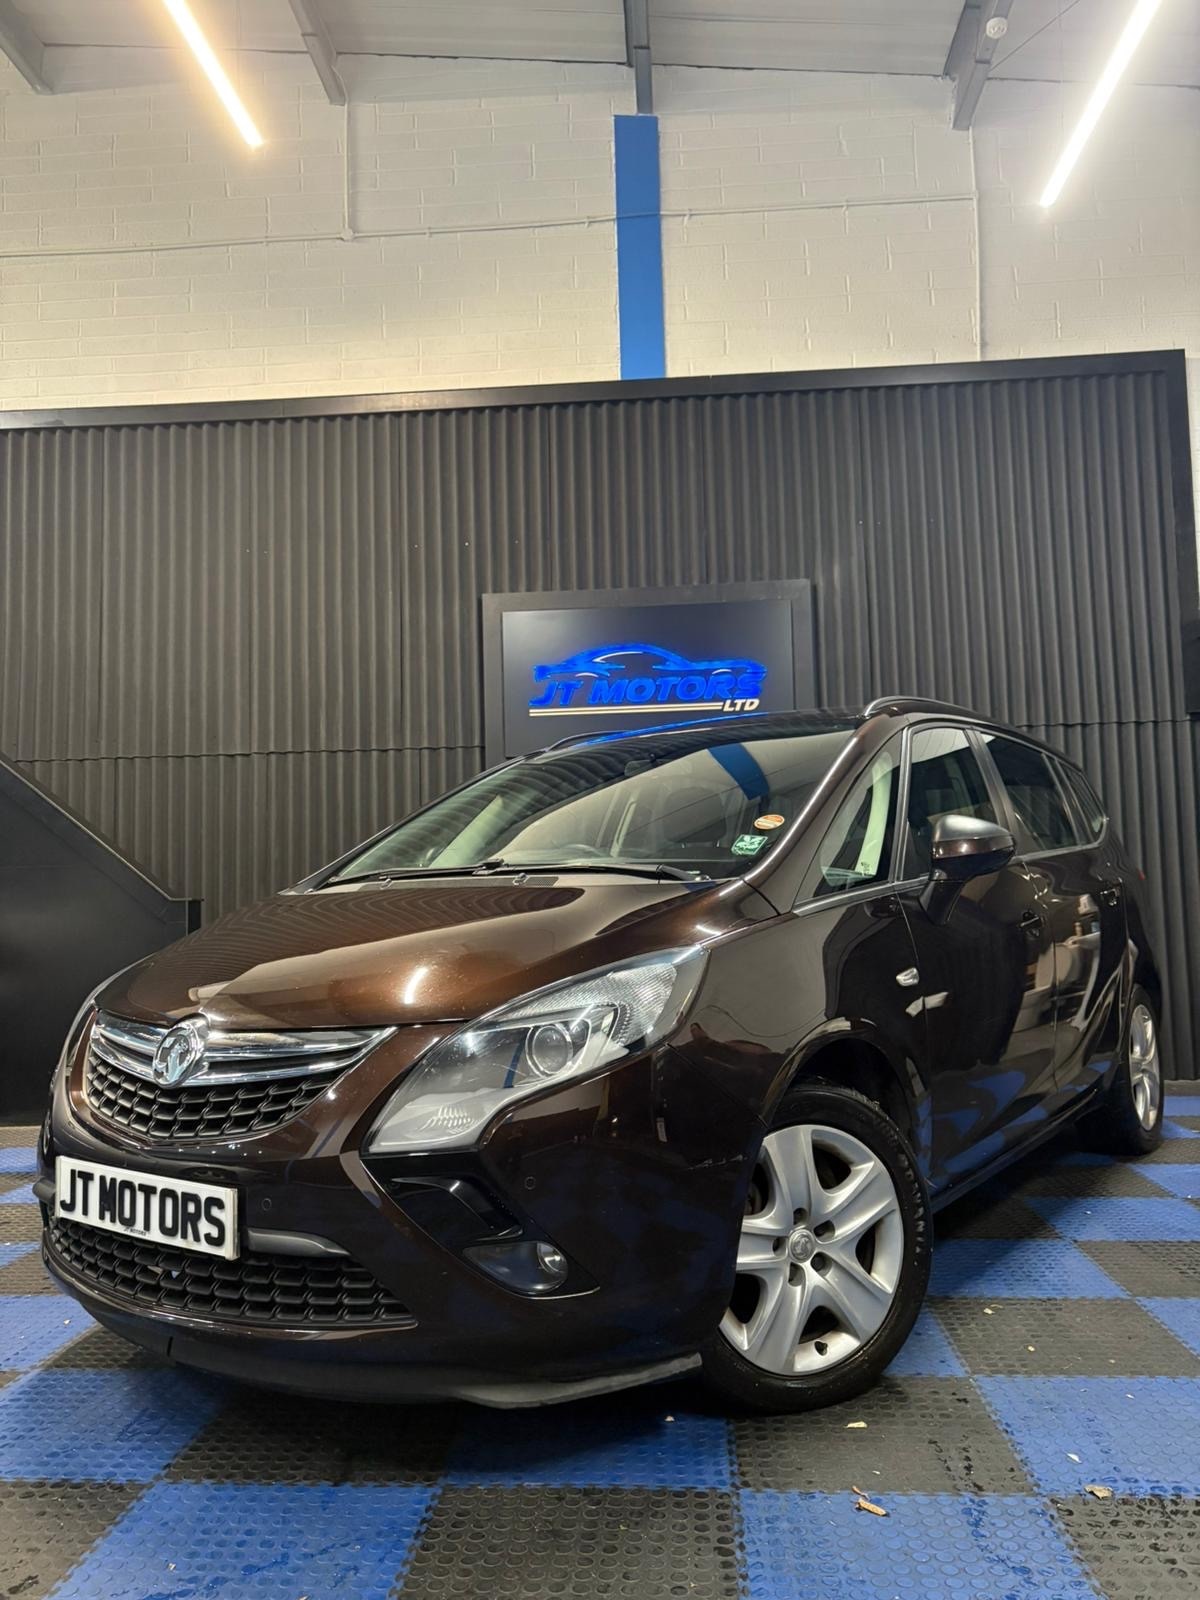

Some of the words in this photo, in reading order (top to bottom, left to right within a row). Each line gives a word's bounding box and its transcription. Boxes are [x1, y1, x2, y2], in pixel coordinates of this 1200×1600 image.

[529, 680, 584, 707] JT
[588, 673, 767, 705] MOTORS
[723, 698, 760, 712] LTD
[59, 1168, 94, 1216] JT
[98, 1174, 226, 1247] MOTORS
